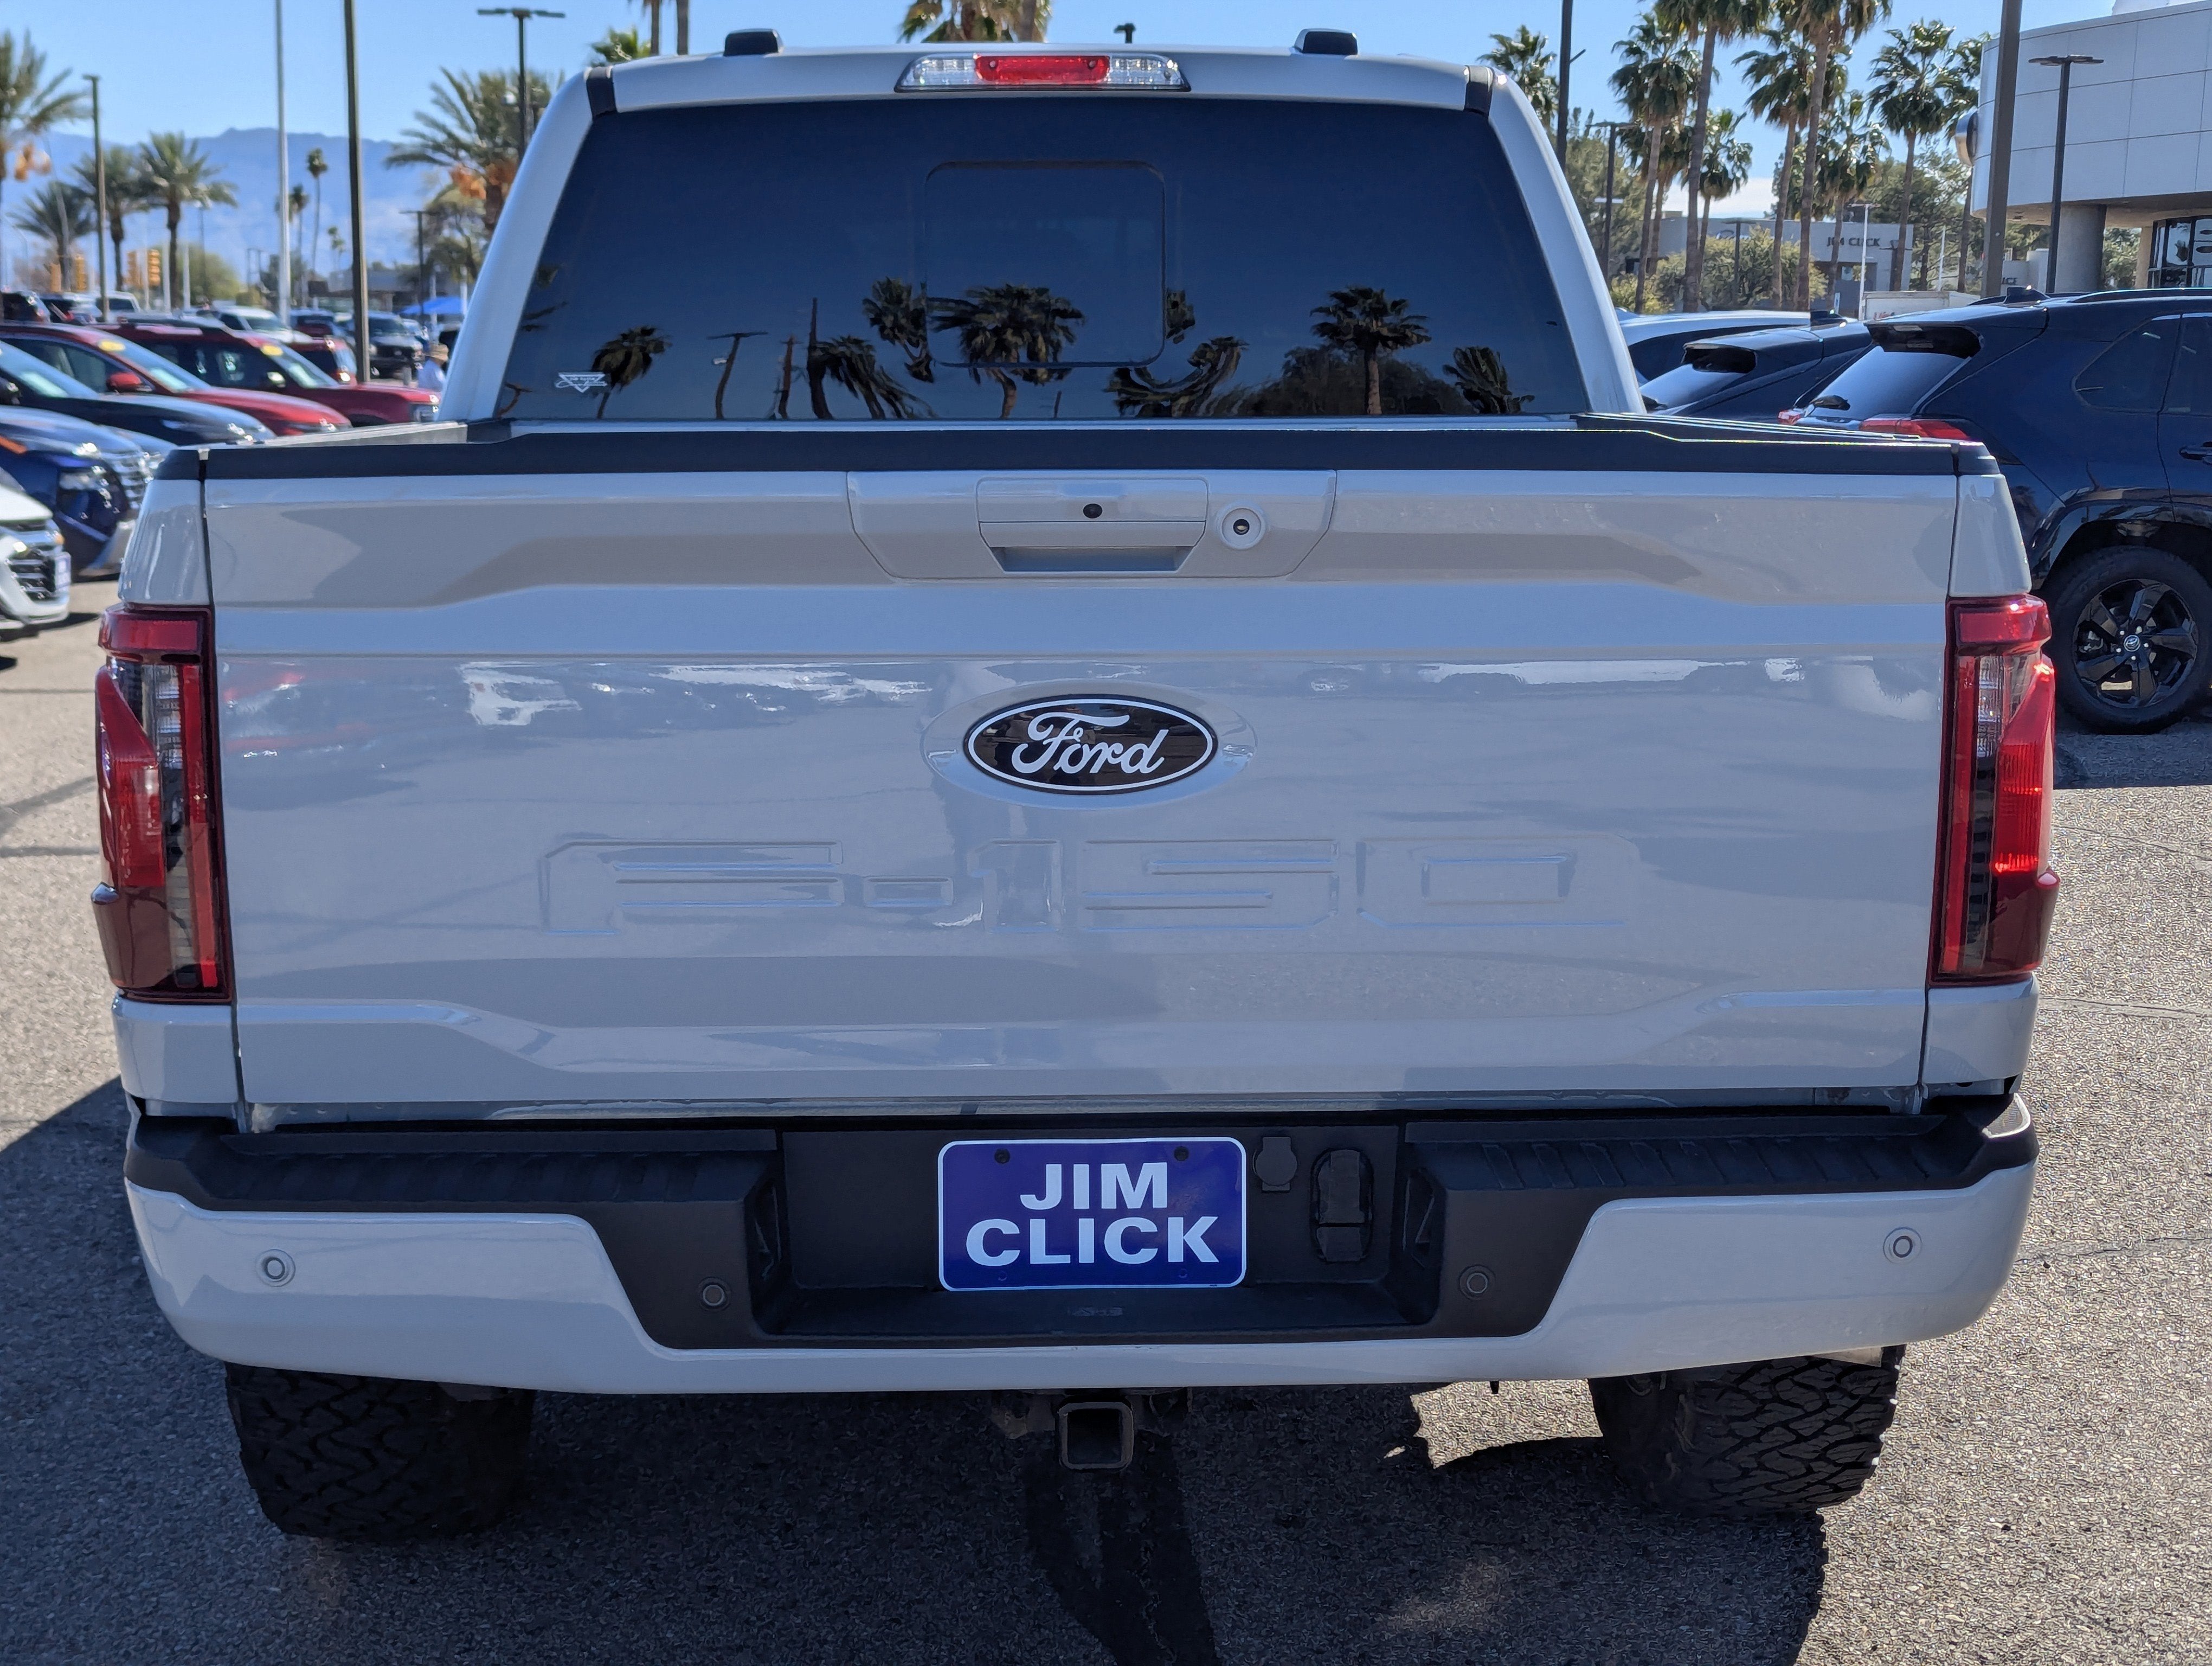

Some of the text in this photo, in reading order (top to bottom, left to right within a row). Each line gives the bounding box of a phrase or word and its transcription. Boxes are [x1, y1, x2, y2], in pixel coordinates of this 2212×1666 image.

[1848, 238, 1881, 247] CLCK
[1011, 712, 1169, 774] Ford
[538, 834, 1641, 934] F-150
[1020, 1162, 1167, 1210] JIM
[966, 1216, 1219, 1266] CLICK
